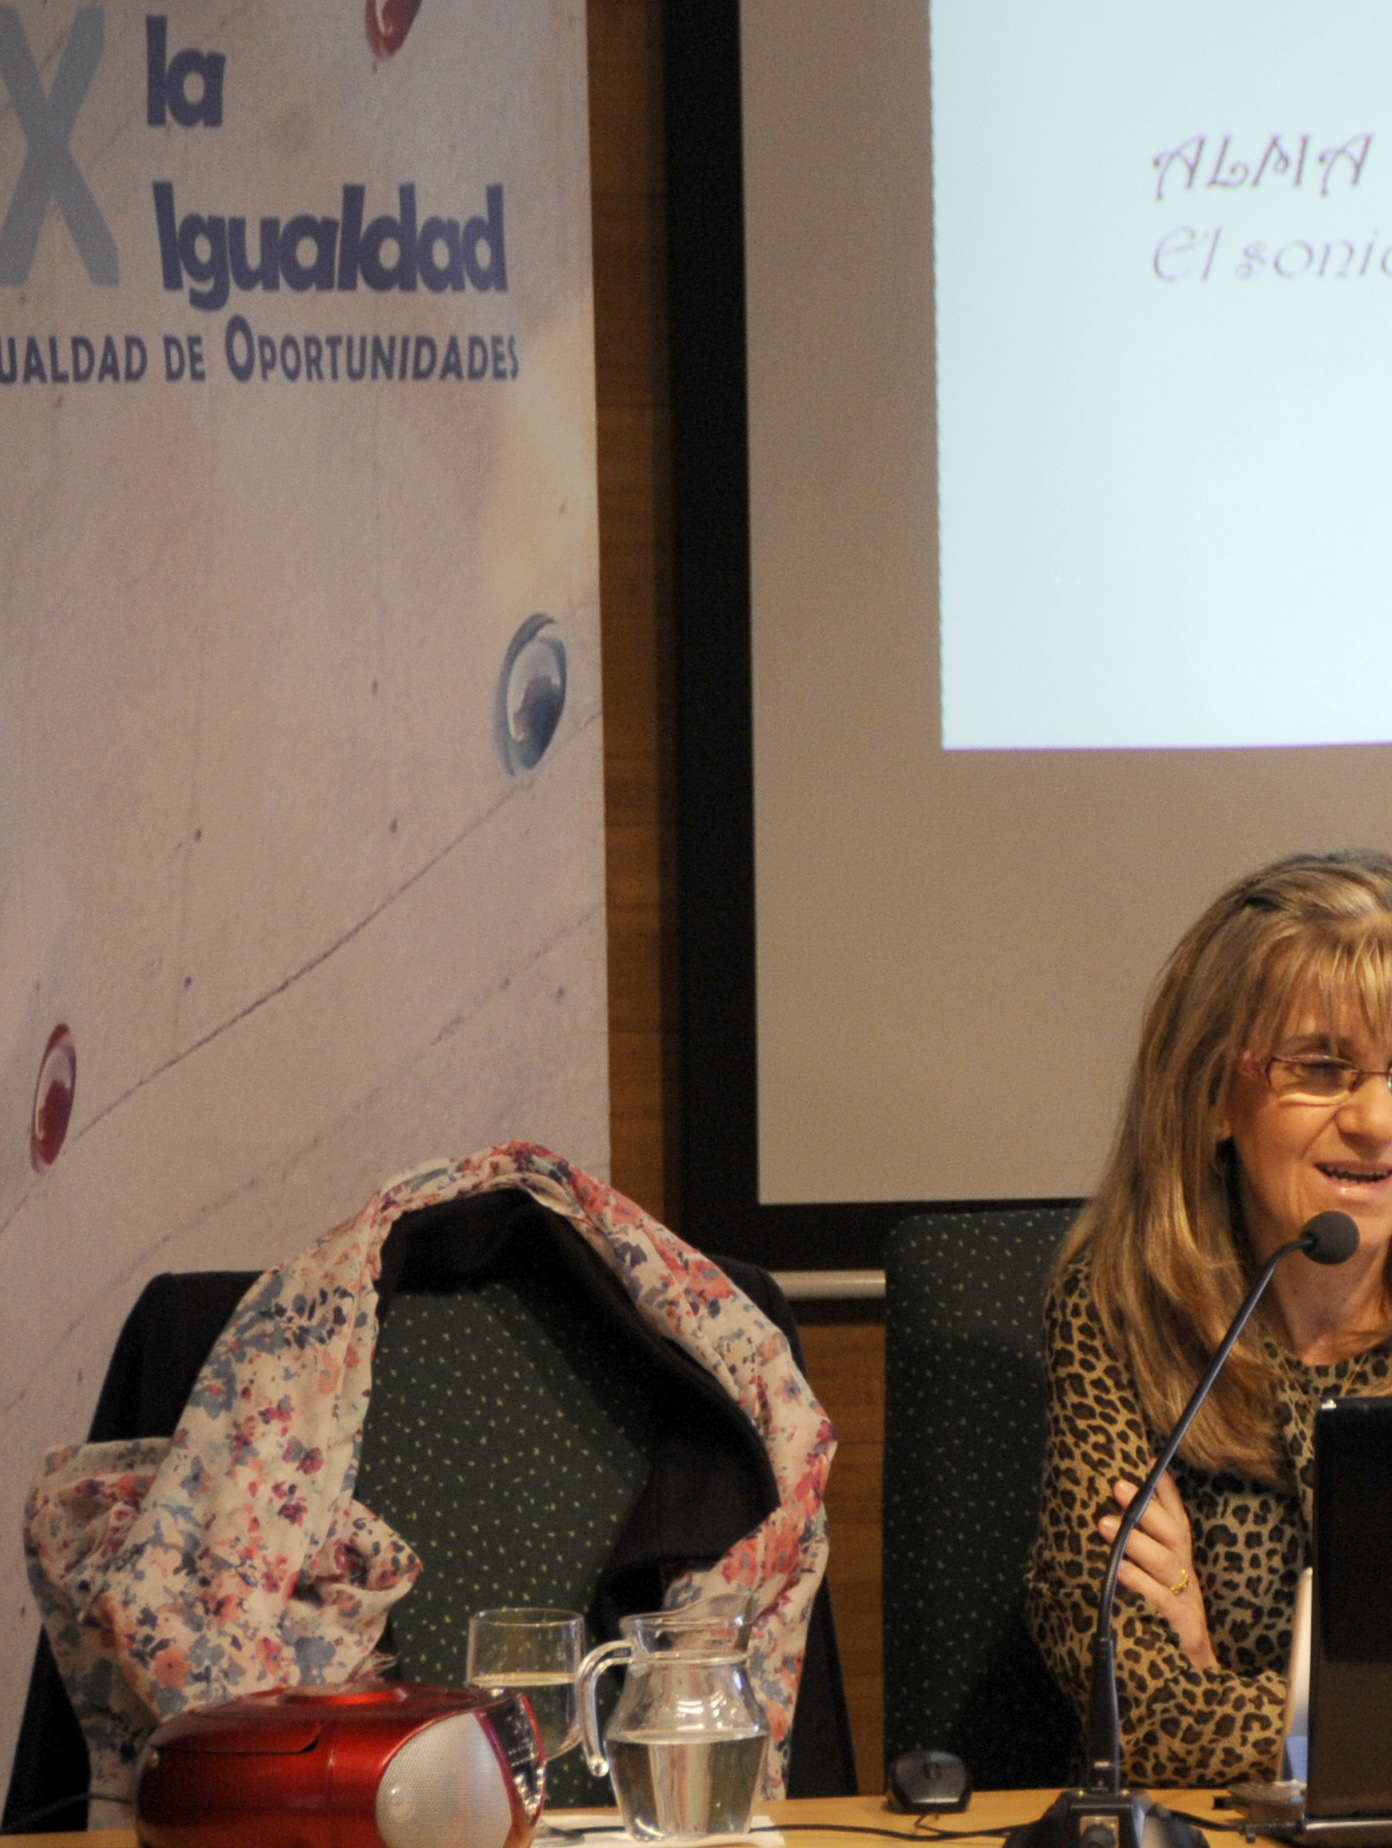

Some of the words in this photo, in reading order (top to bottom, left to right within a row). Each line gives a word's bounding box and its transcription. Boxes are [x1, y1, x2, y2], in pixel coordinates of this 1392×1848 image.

[145, 14, 226, 127] la
[1152, 132, 1375, 201] ALMA
[152, 180, 508, 311] Igualdad
[1152, 226, 1223, 282] El
[163, 334, 206, 383] DE
